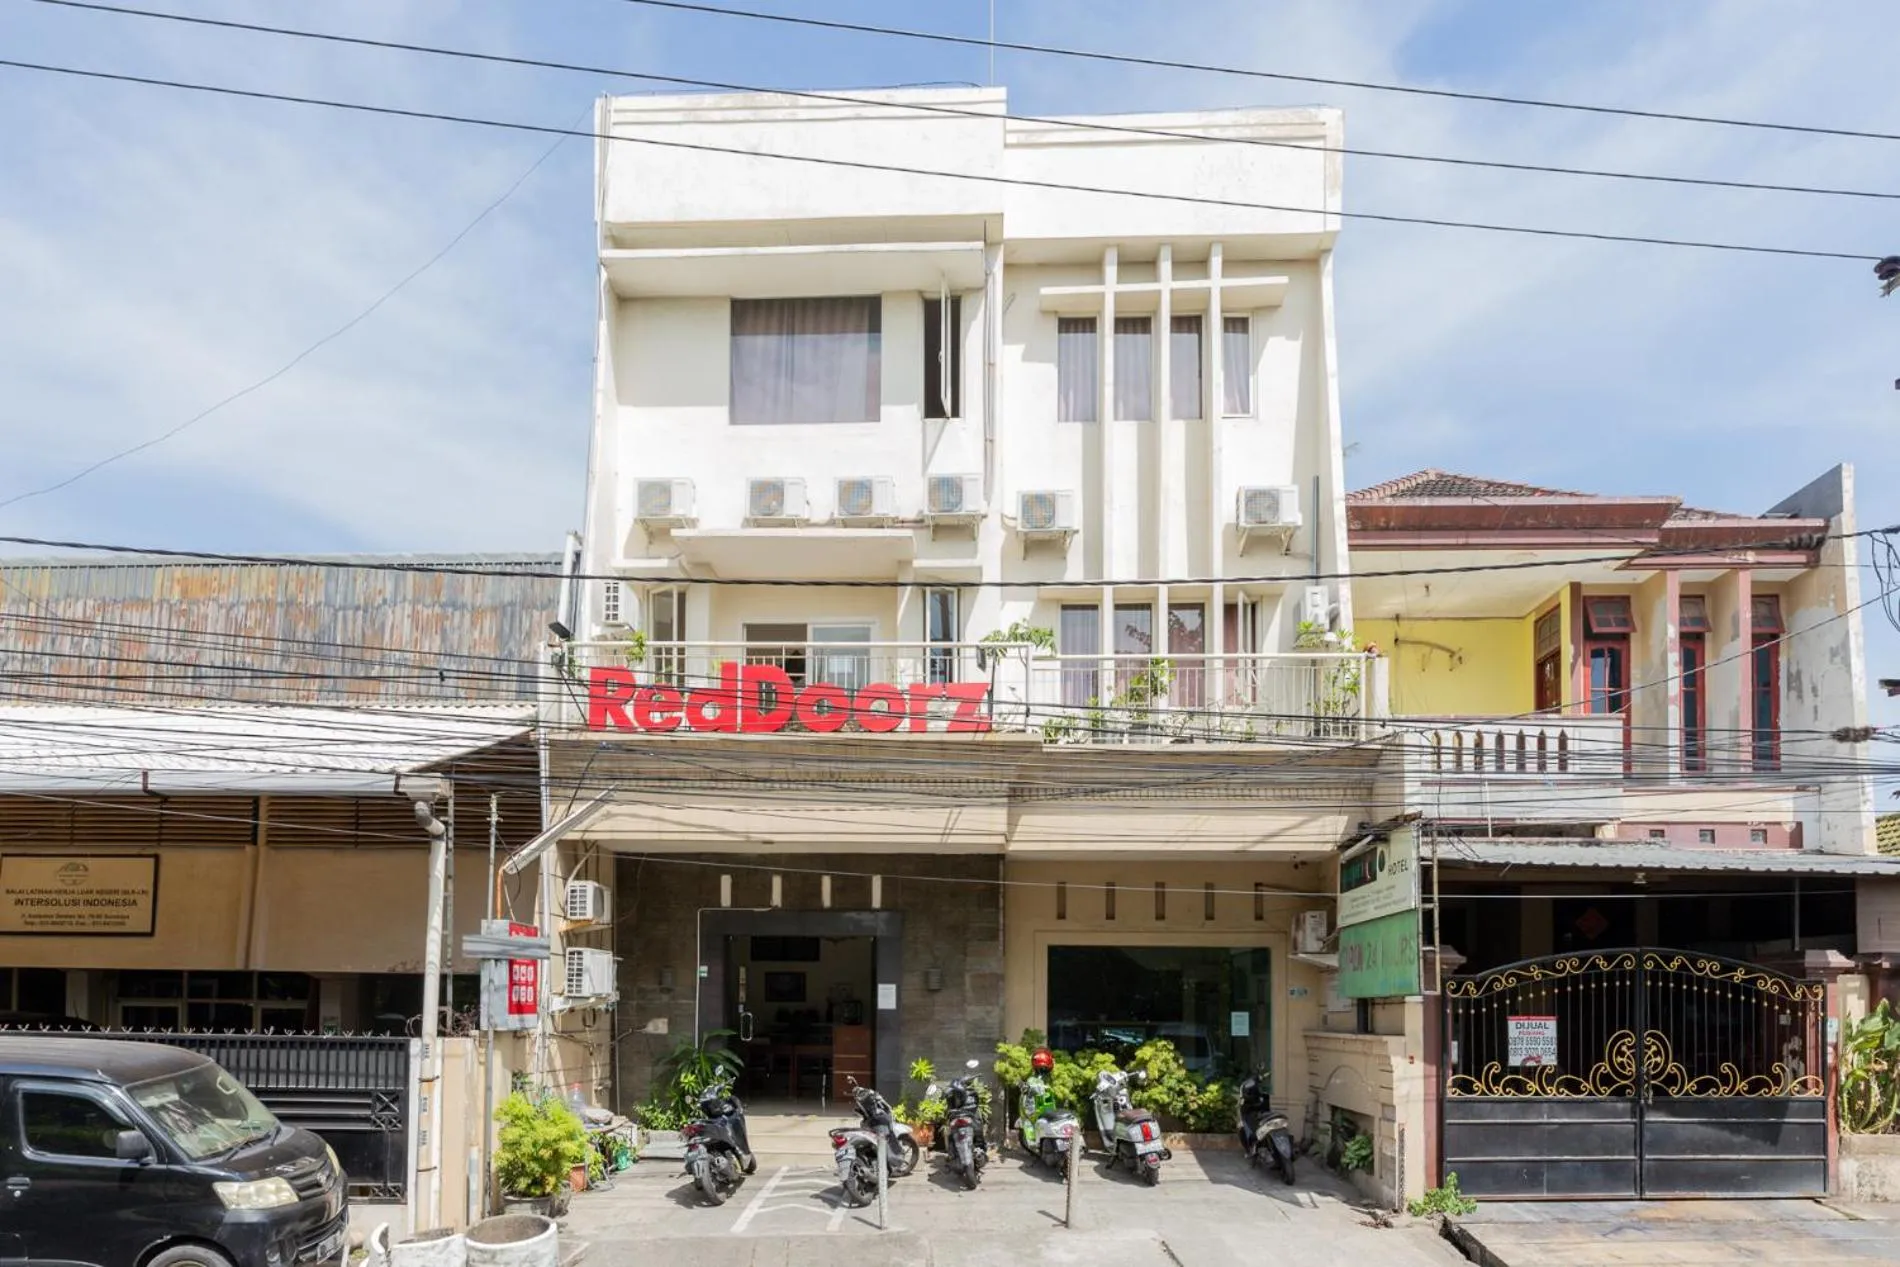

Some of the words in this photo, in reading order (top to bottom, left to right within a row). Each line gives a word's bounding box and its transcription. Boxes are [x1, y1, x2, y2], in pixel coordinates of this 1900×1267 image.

[588, 661, 993, 733] RedDoorz
[1388, 859, 1409, 876] HOTEL
[14, 897, 81, 907] INTERSOLUSI
[82, 898, 138, 907] INDONESIA
[1515, 1022, 1550, 1030] DIJUAL
